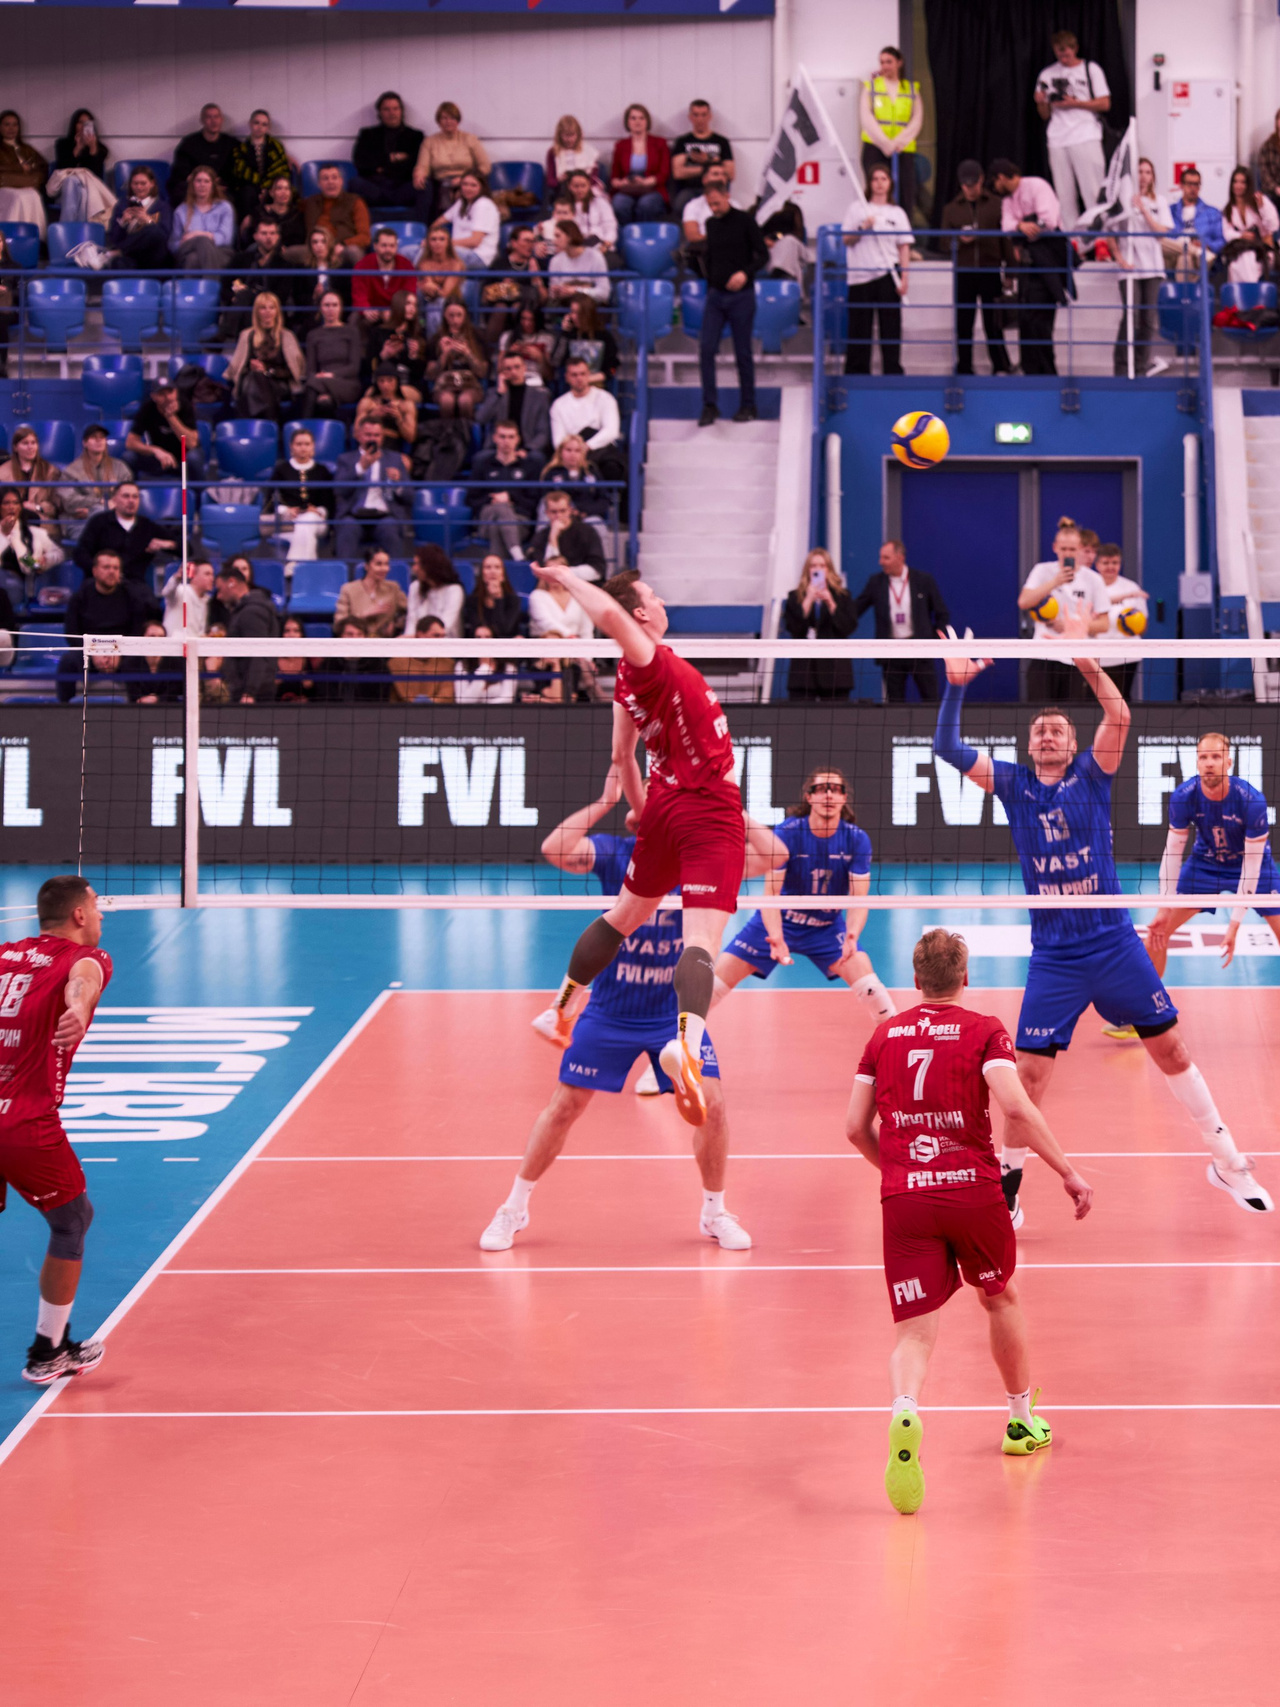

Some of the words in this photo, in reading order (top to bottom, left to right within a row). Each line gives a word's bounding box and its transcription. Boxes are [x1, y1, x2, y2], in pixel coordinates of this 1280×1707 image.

[151, 747, 293, 826] FVL
[398, 746, 539, 826] FVL
[1038, 807, 1071, 843] 13
[1032, 846, 1092, 874] VAST
[810, 868, 833, 895] 17
[623, 936, 684, 956] VAST
[733, 938, 760, 956] VAST
[616, 963, 677, 985] FVLPRO
[0, 972, 34, 1018] 18
[1151, 990, 1167, 1008] 13
[888, 1025, 916, 1039] DIMA
[1024, 1027, 1056, 1037] VAST
[569, 1062, 599, 1077] VAST
[907, 1049, 935, 1101] 7
[893, 1278, 928, 1306] FVL
